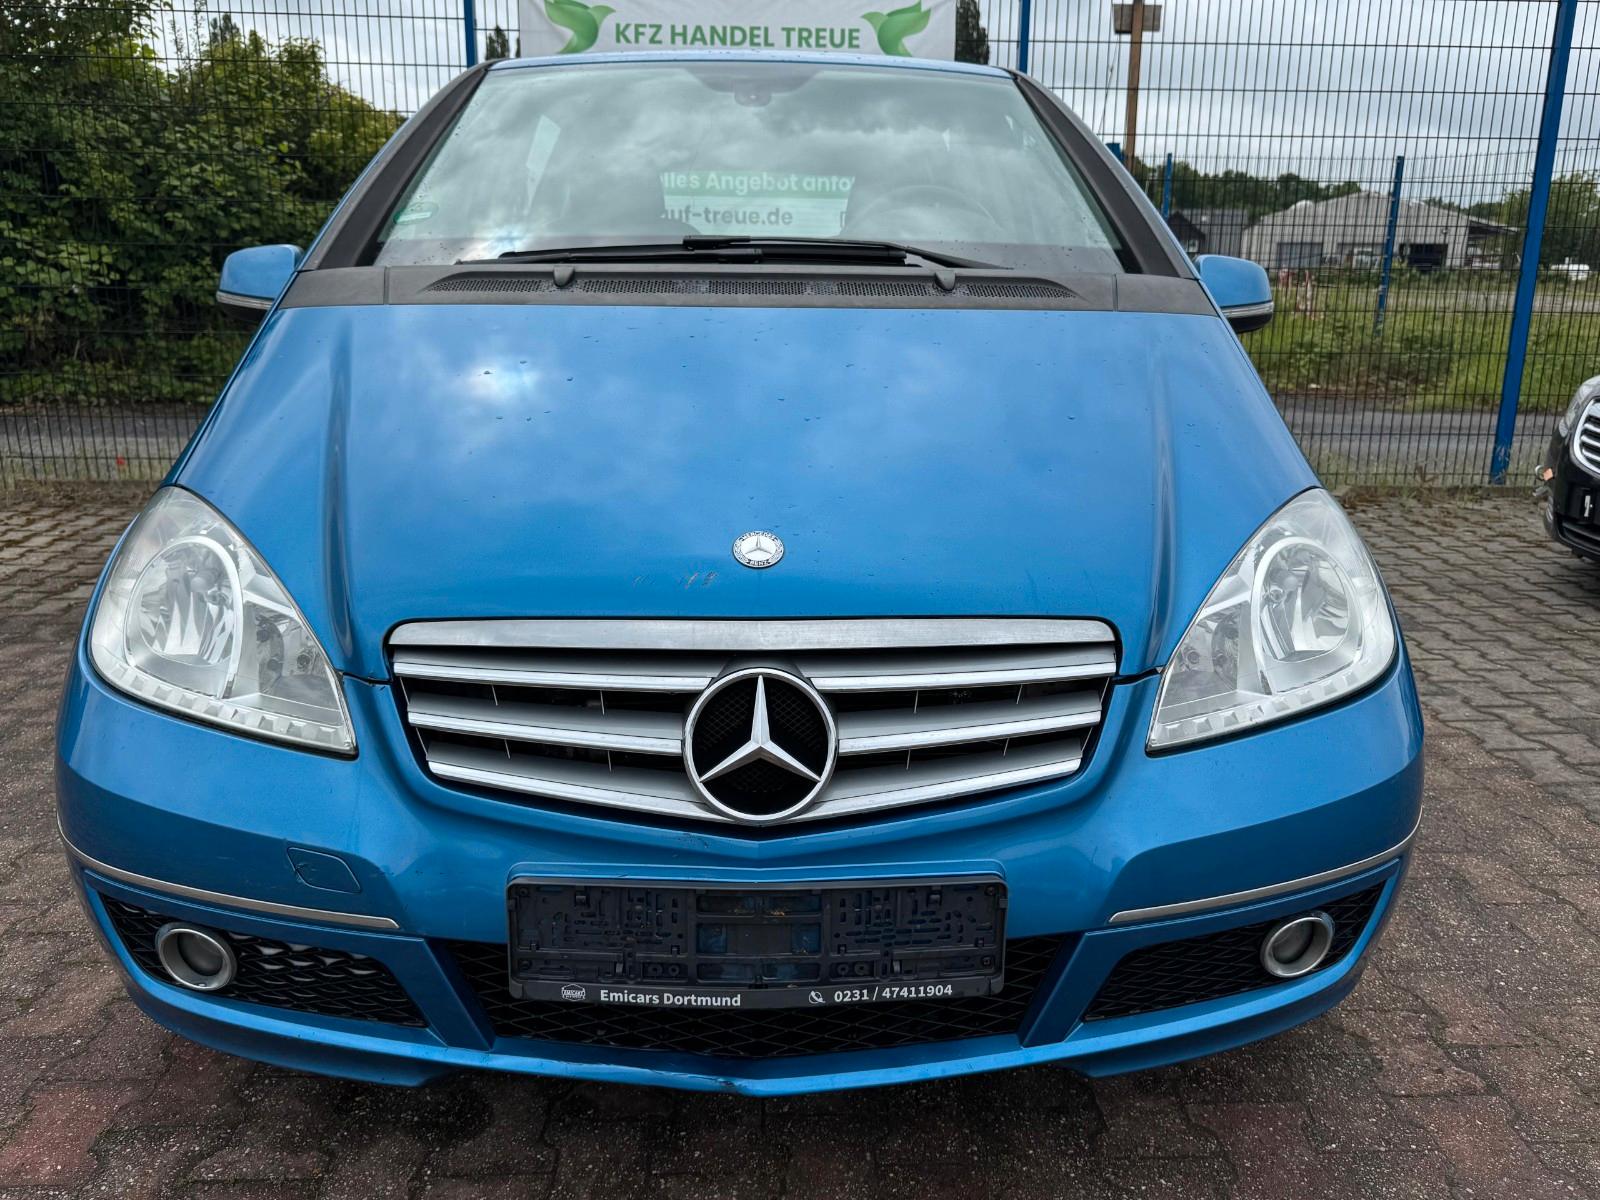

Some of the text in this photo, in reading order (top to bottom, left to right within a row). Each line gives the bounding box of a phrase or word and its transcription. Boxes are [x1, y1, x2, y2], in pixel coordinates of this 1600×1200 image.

[615, 23, 860, 49] KFZ HANDEL TREUE
[660, 172, 700, 189] lles
[705, 171, 799, 196] Angebot
[600, 989, 741, 1007] Emicars Dortmund
[834, 989, 869, 1003] 0231
[882, 984, 953, 999] 47411904
